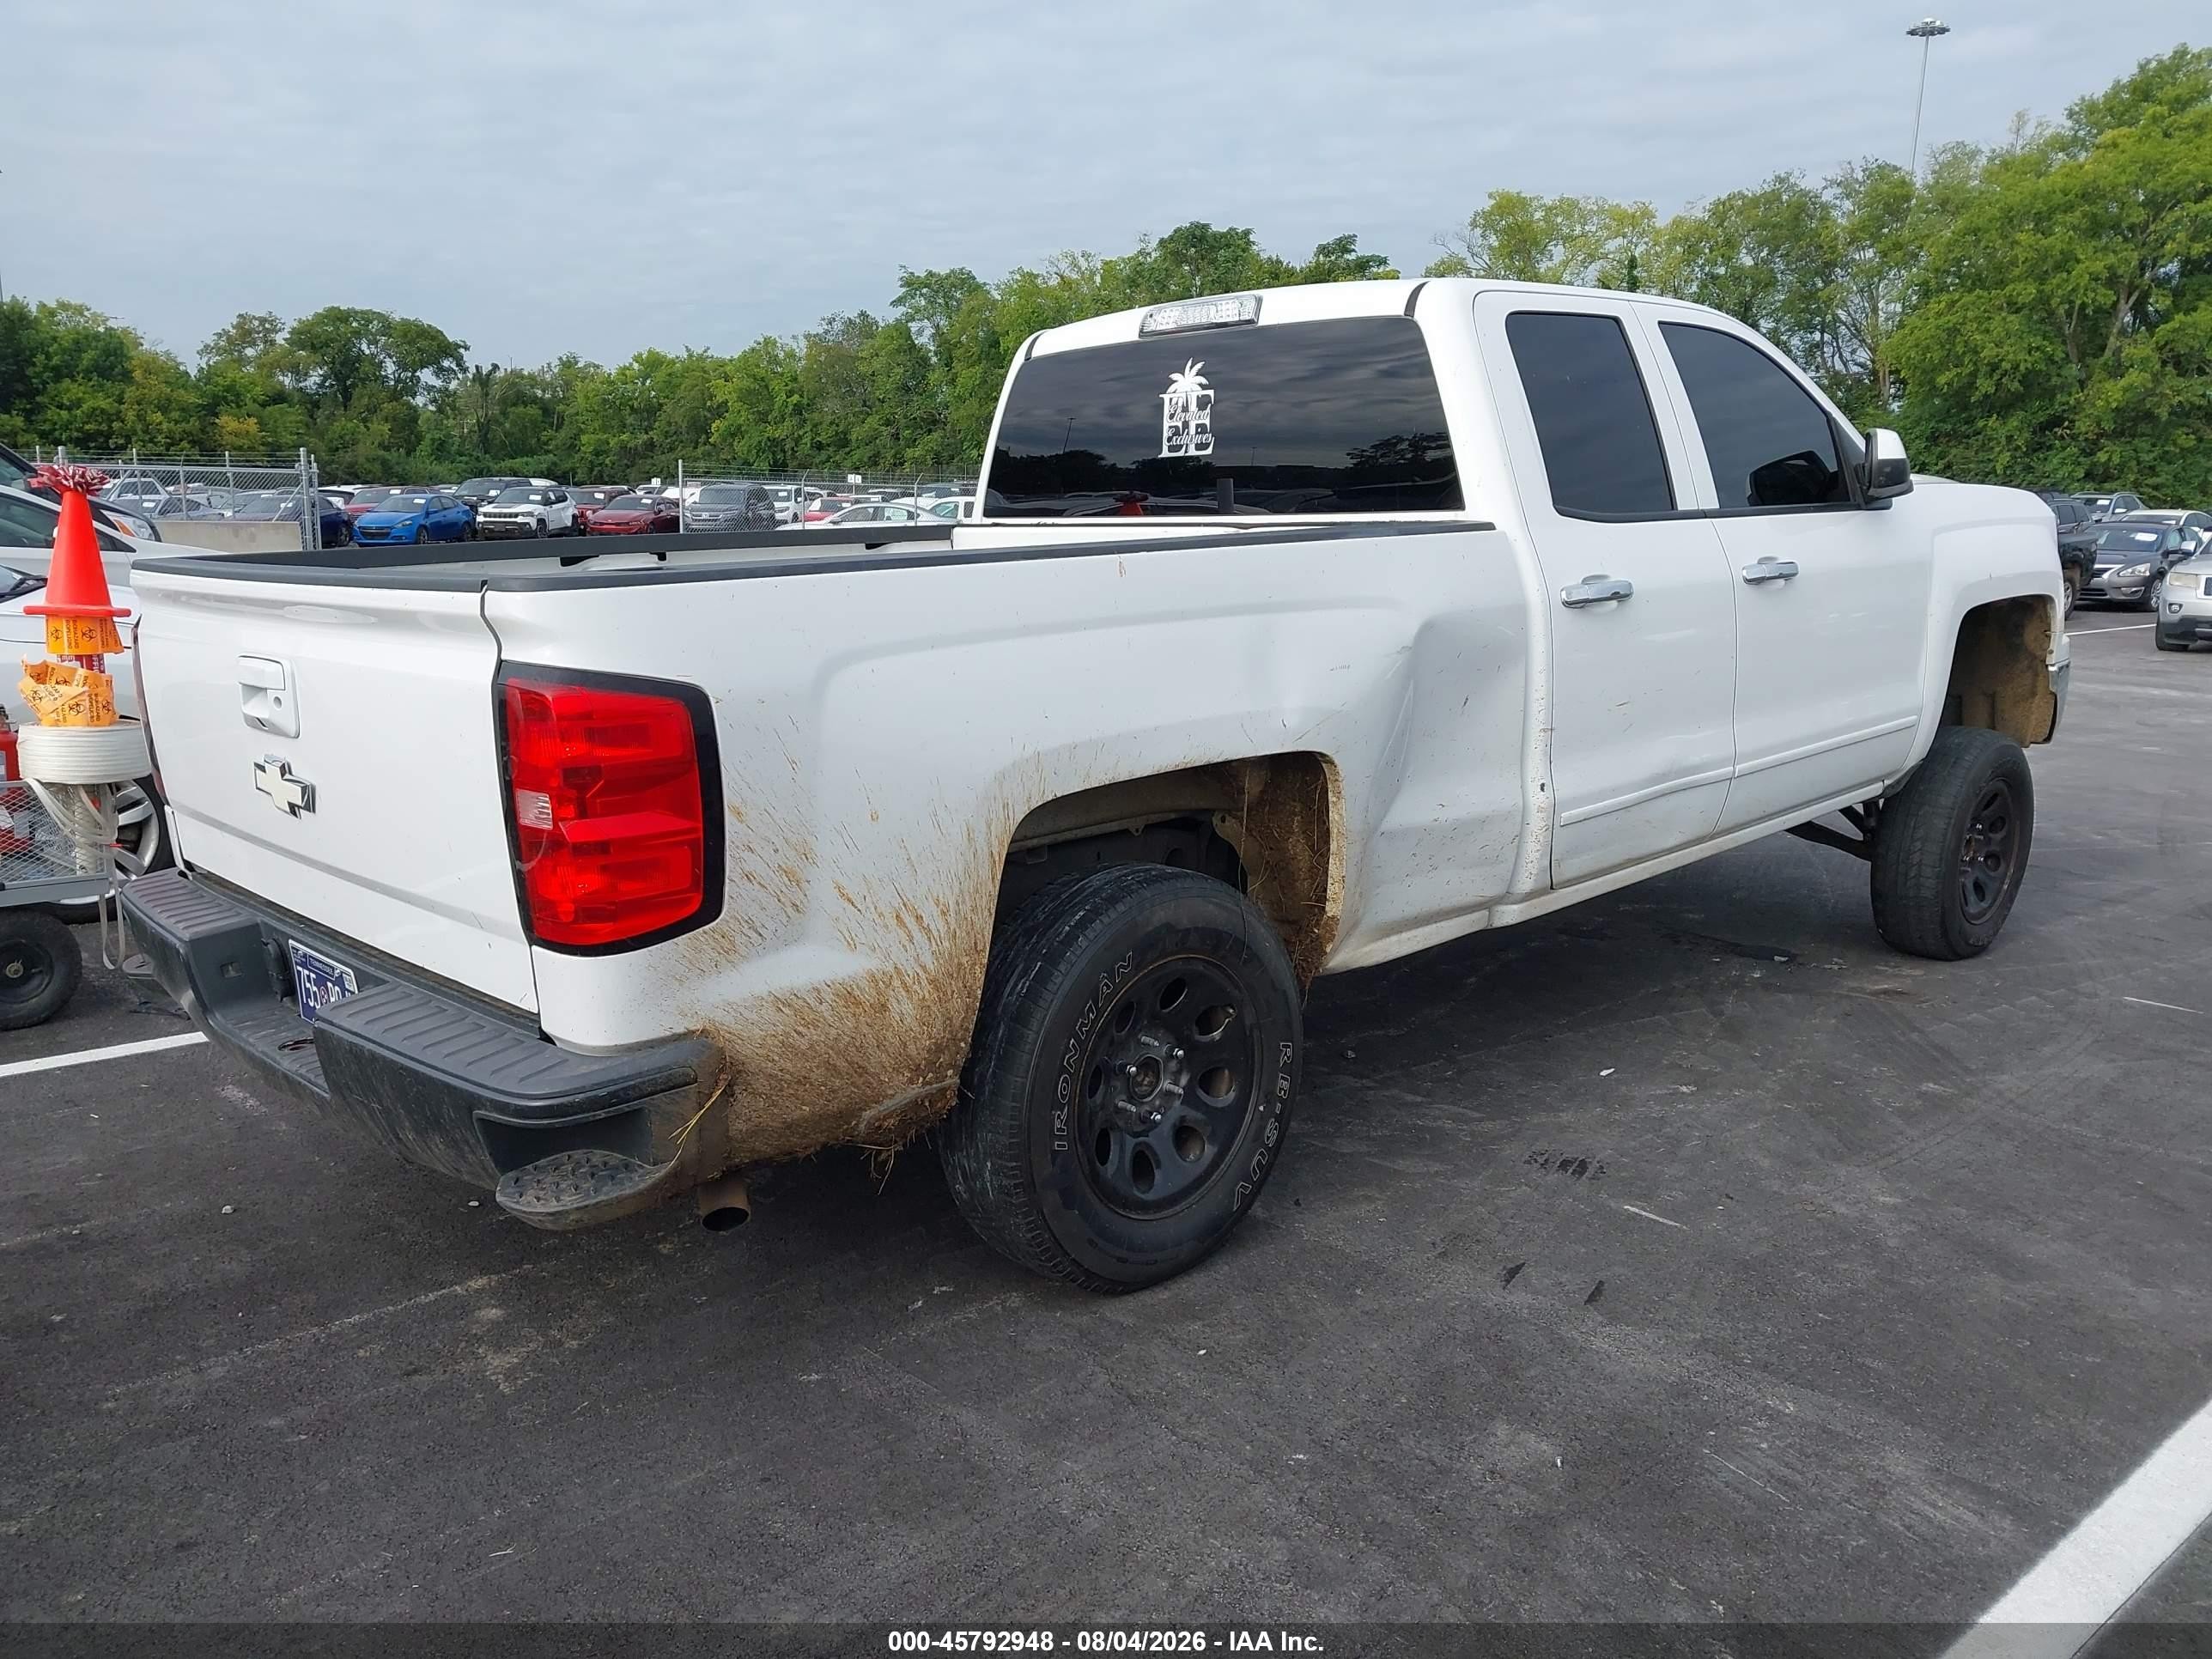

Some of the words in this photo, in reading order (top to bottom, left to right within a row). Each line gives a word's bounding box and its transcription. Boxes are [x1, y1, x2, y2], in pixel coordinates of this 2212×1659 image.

[1167, 403, 1212, 423] Elevated
[1165, 428, 1212, 446] Exclusives
[1054, 951, 1133, 1151] IRONMAN
